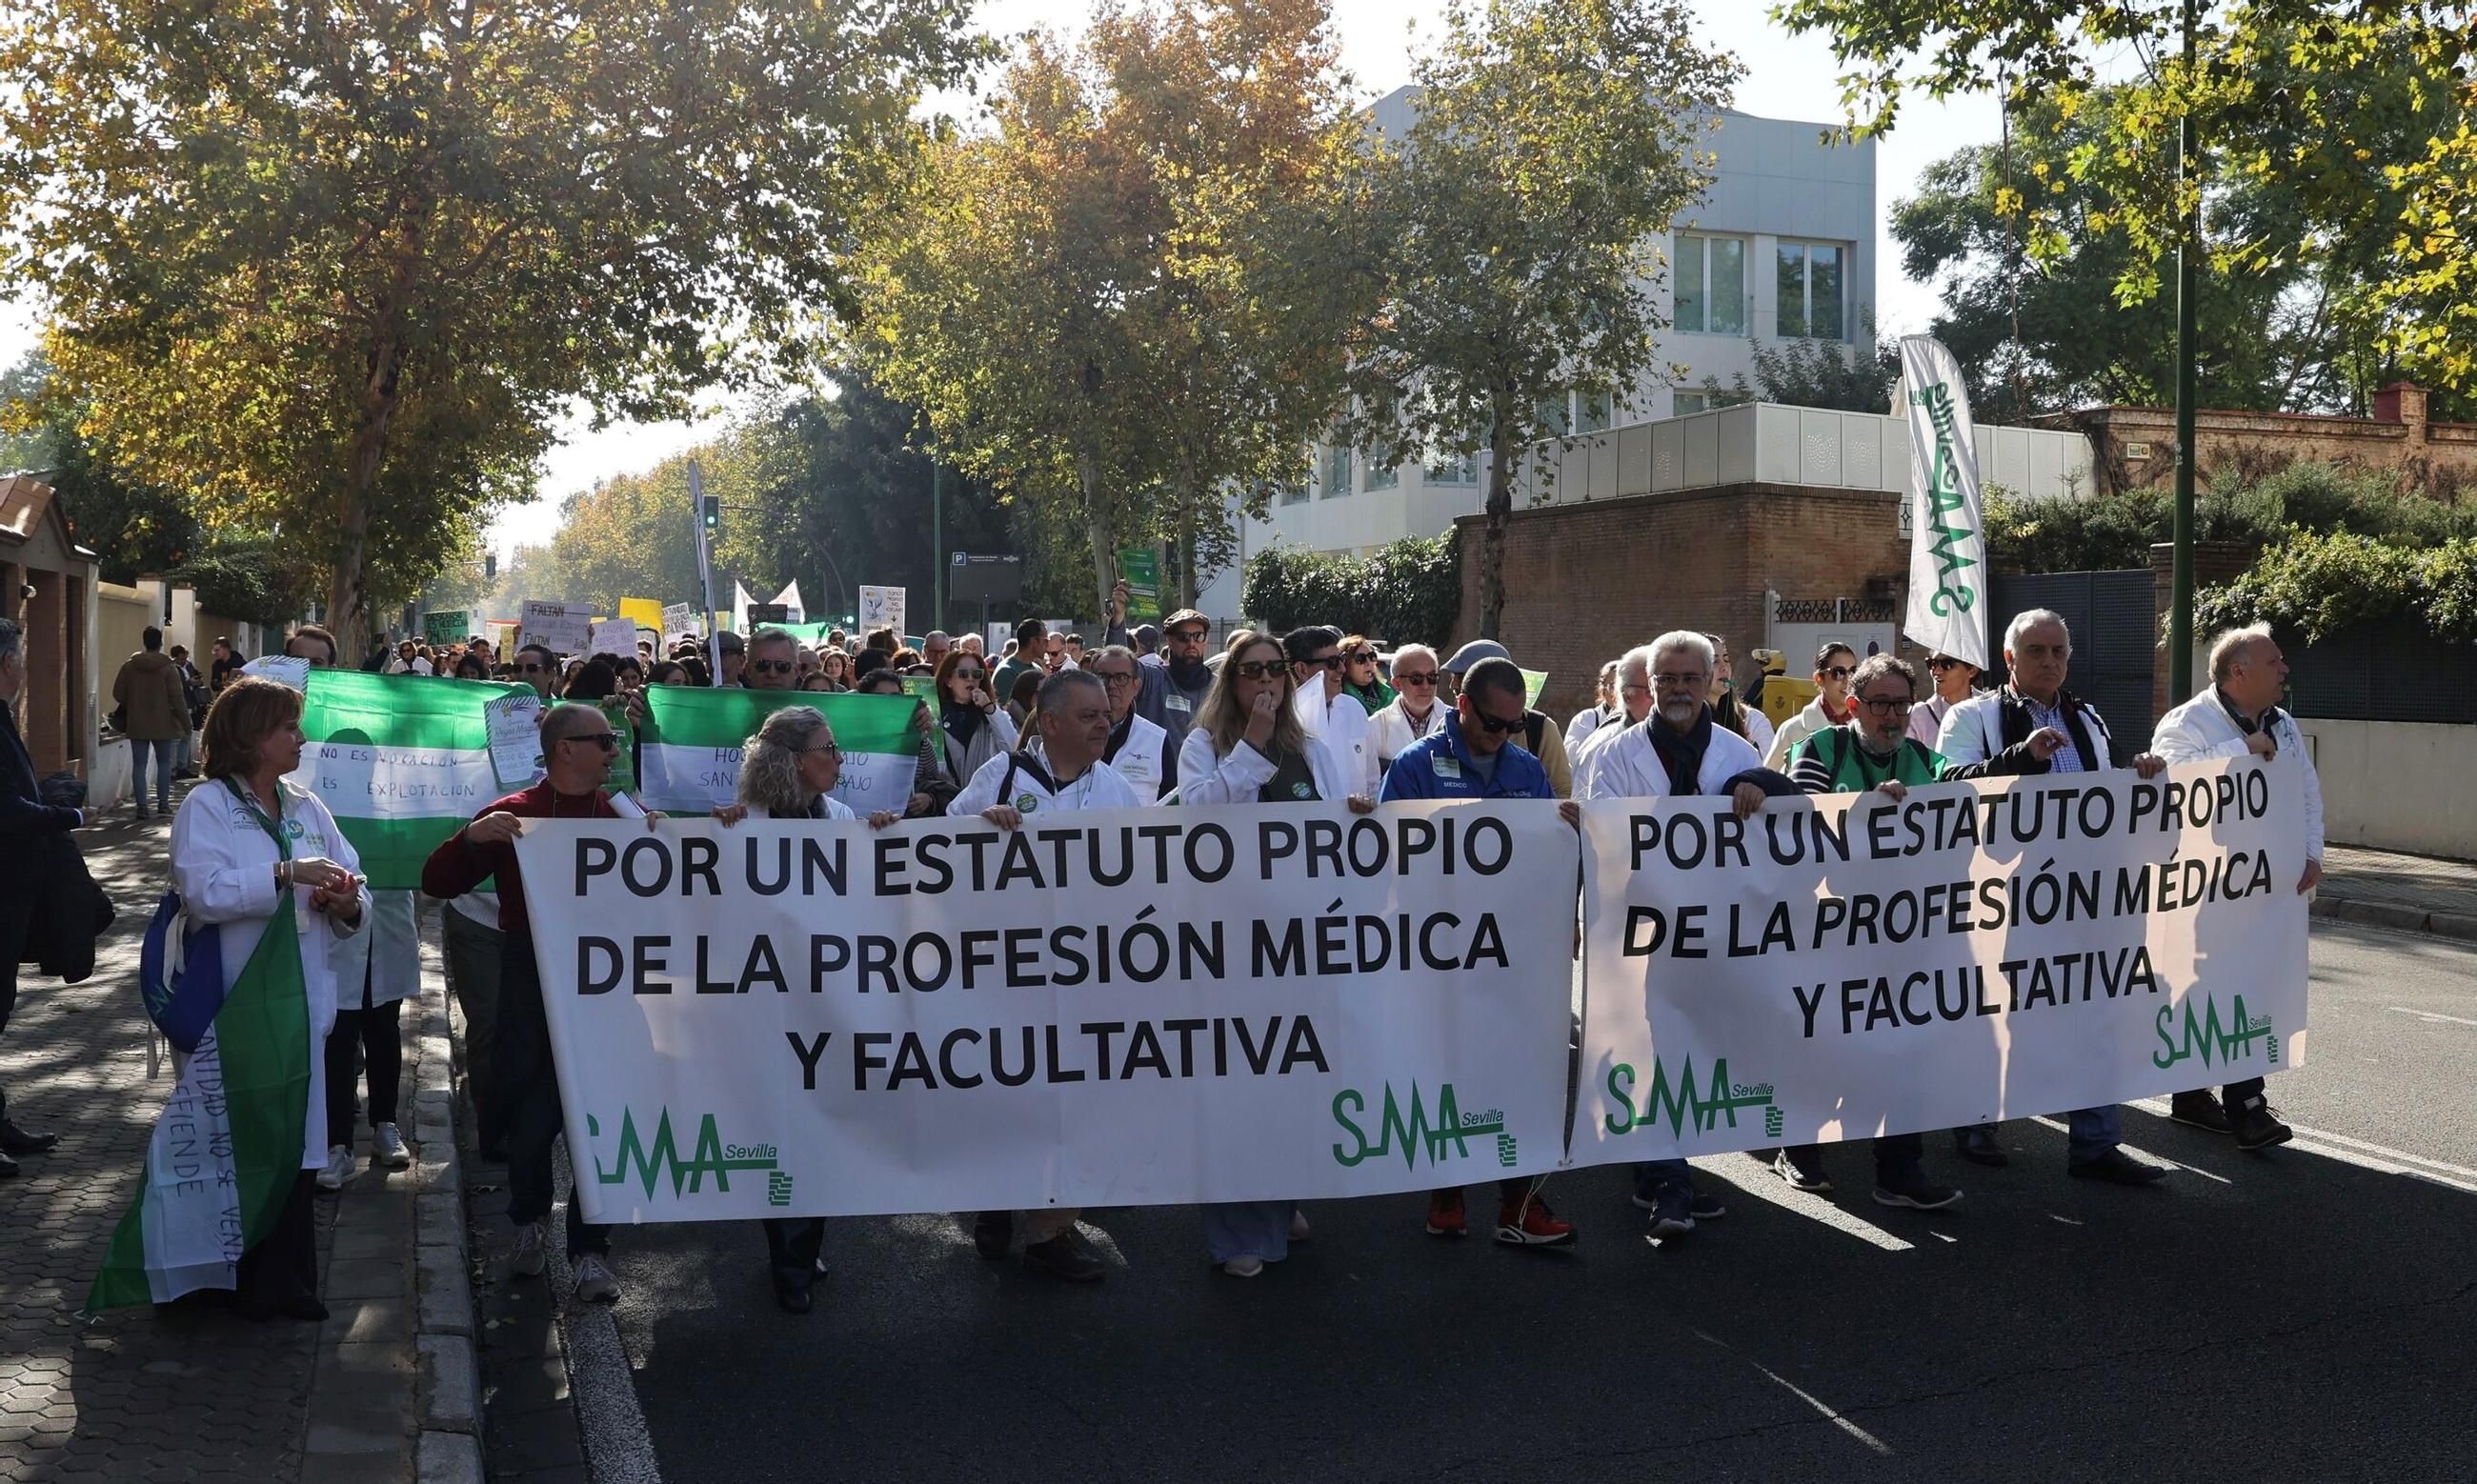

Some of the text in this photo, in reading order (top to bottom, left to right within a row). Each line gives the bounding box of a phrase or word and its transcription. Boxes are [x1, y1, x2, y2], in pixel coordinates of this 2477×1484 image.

[955, 554, 963, 564] P
[320, 747, 338, 759] NO
[351, 750, 368, 761] ES
[322, 776, 337, 790] ES
[574, 816, 1513, 897] POR UN ESTATUTO PROPIO
[1629, 768, 2268, 872] POR UN ESTATUTO PROPIO
[1622, 847, 2272, 959] DE LA PROFESIÓN MÉDICA
[576, 896, 1510, 996] DE LA PROFESIÓN MÉDICA
[1792, 946, 2158, 1038] Y FACULTATIVA
[2153, 990, 2251, 1072] SMA
[2249, 1013, 2272, 1030] Sevilla
[192, 1024, 228, 1117] ANIDAD
[785, 1014, 1330, 1092] Y FACULTATIVA
[1732, 1083, 1774, 1097] Sevilla
[1332, 1076, 1469, 1173] SMA
[1461, 1109, 1504, 1126] Sevilla
[1605, 1051, 1738, 1141] SMA
[209, 1132, 232, 1158] NO
[216, 1168, 237, 1189] SE
[724, 1143, 777, 1159] Sevilla
